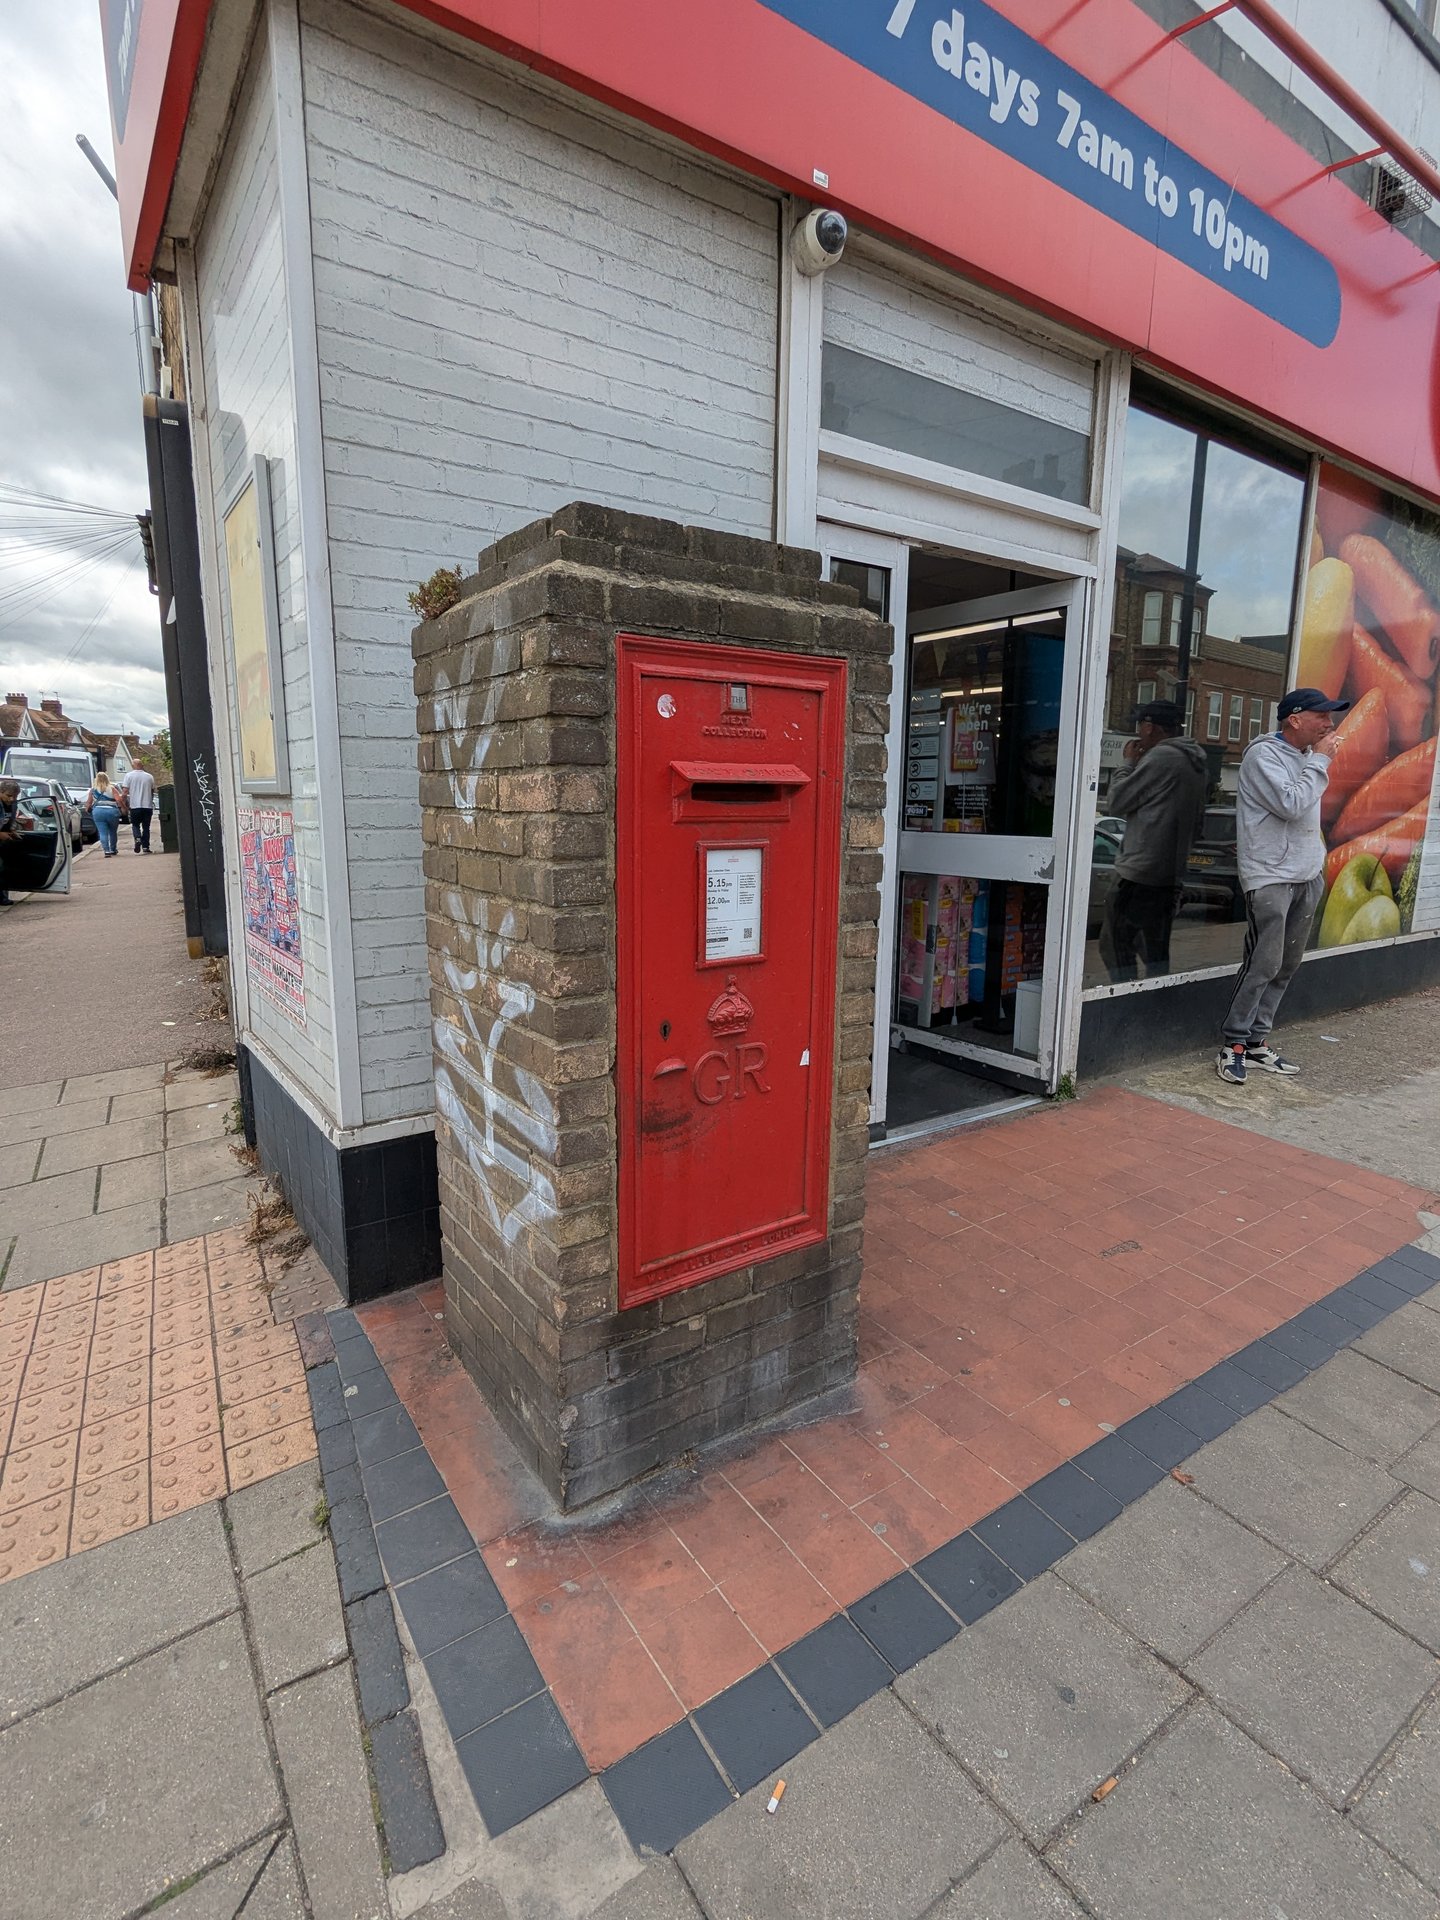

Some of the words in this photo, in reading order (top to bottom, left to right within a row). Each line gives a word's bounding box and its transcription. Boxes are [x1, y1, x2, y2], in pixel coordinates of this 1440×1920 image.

[931, 9, 1041, 127] days
[1056, 89, 1134, 191] 7am
[1144, 157, 1178, 219] to
[1189, 187, 1270, 280] 10pm
[958, 702, 992, 715] We're
[721, 715, 752, 726] NEXT
[957, 720, 989, 734] open
[702, 726, 767, 740] COLLECTION
[692, 1041, 772, 1105] GR
